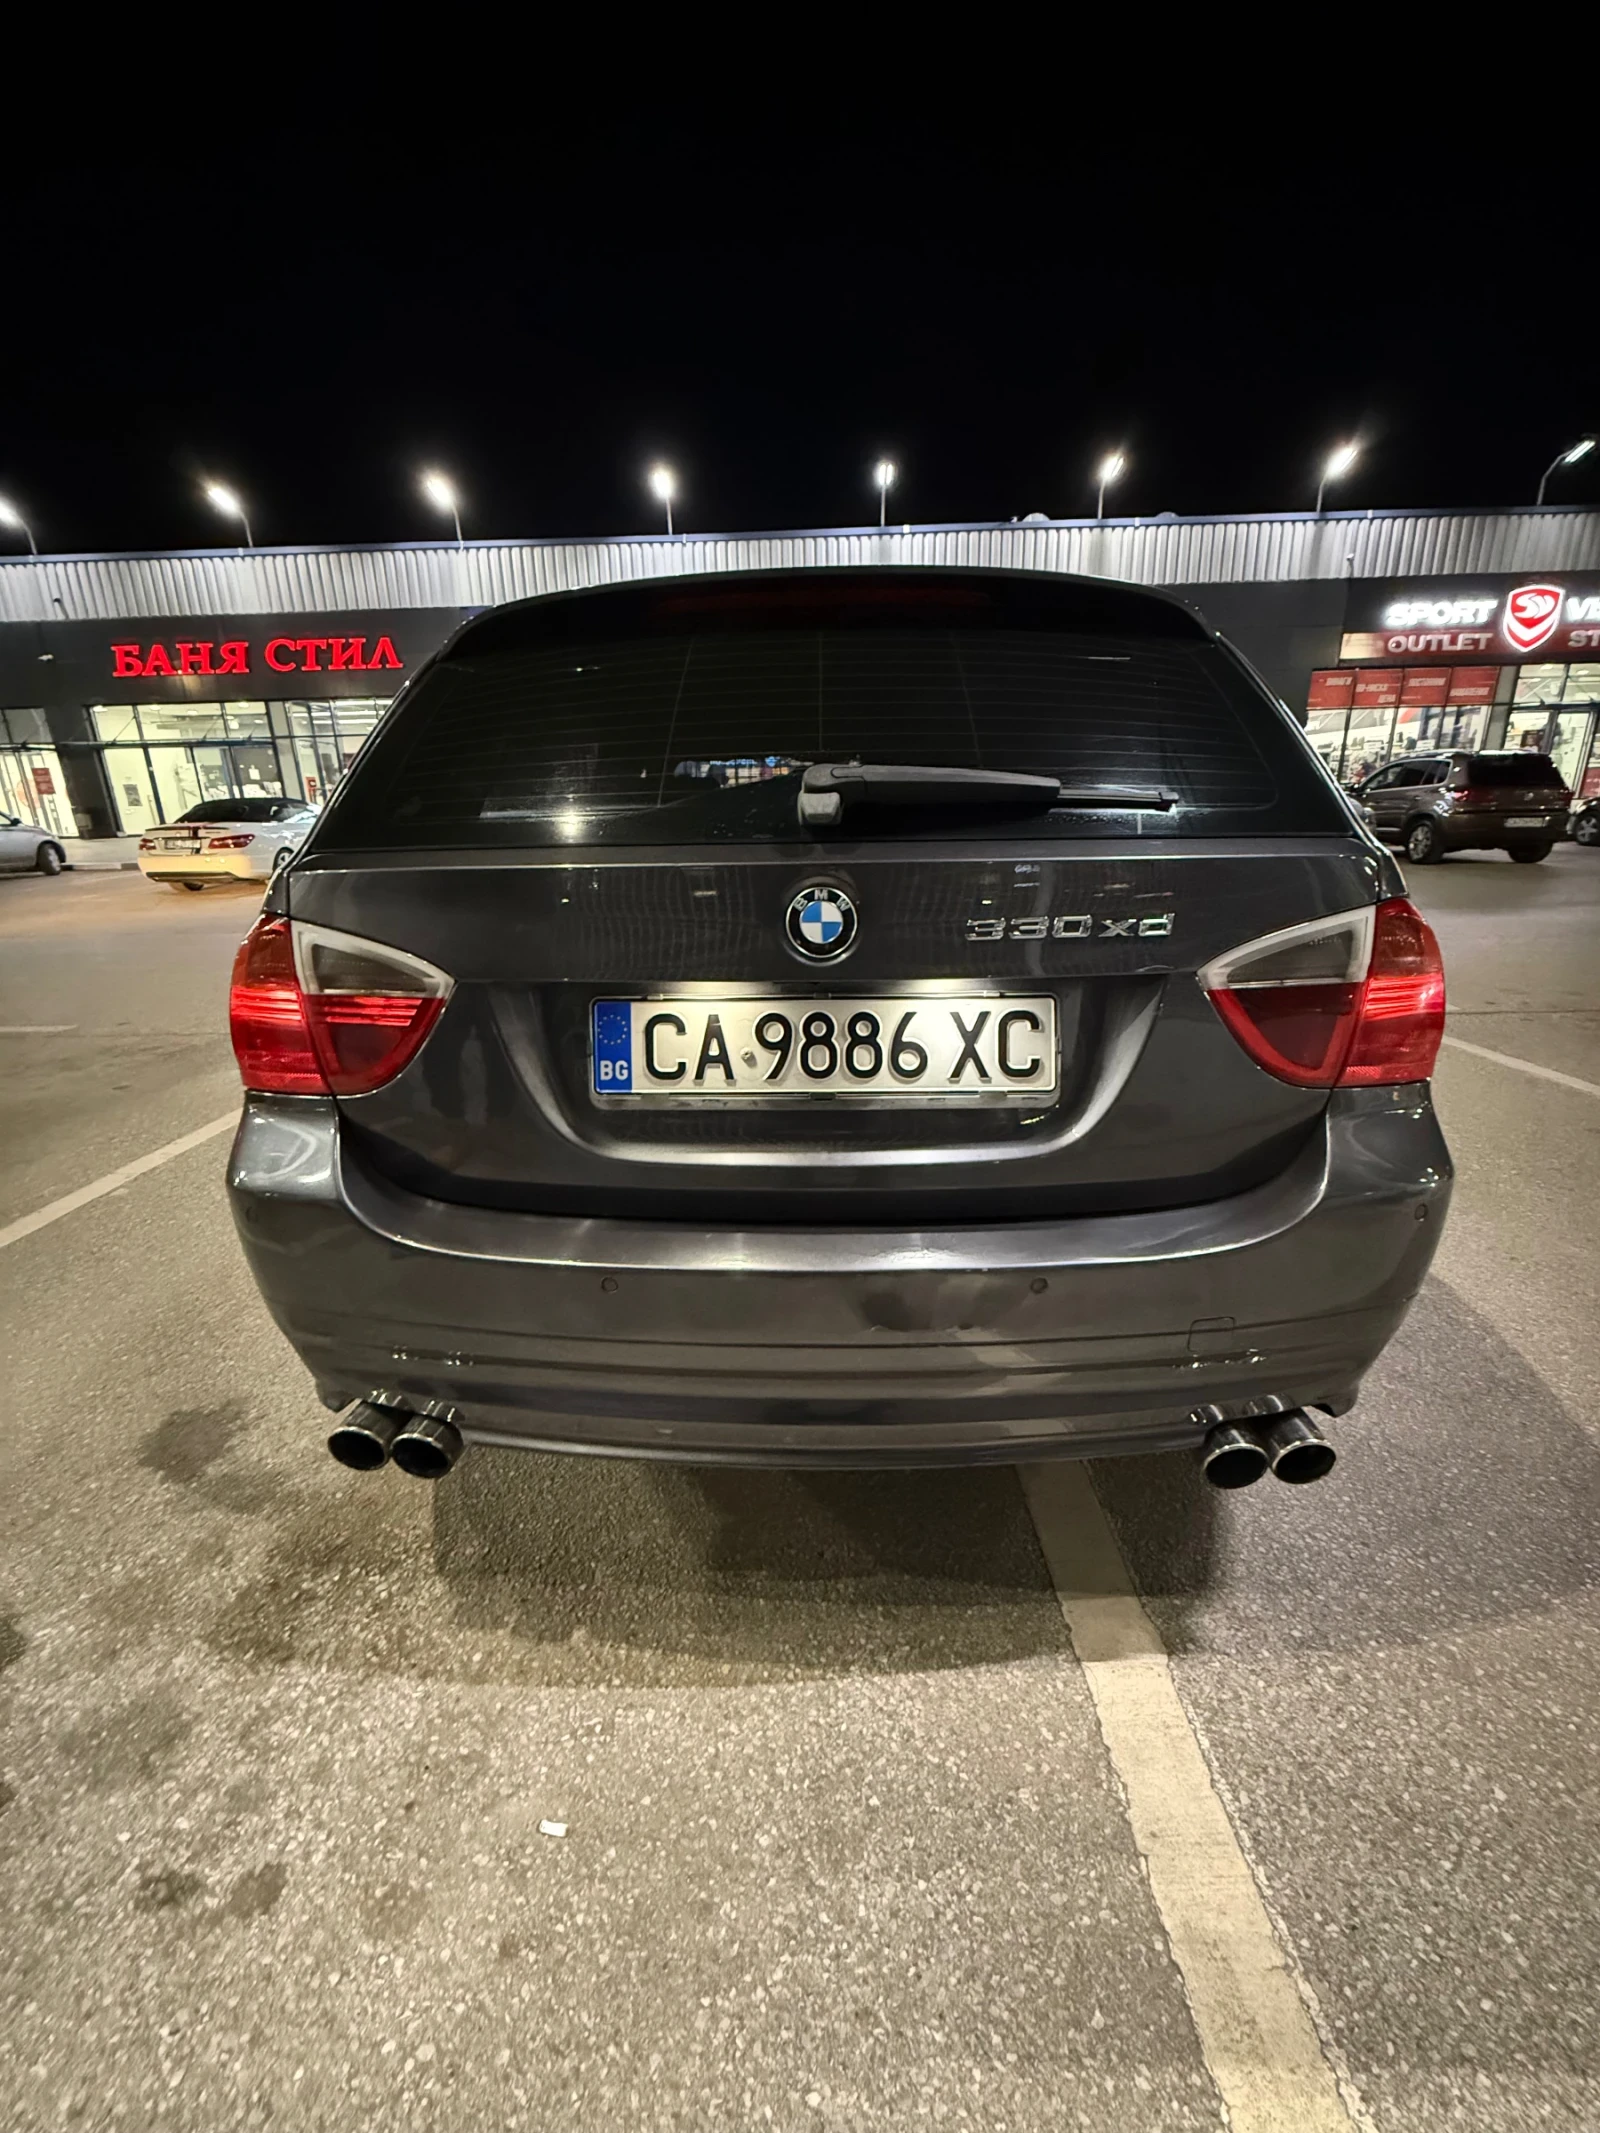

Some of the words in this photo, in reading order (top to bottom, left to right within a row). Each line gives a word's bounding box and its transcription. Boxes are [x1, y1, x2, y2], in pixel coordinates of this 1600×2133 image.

[1387, 600, 1498, 626] SPORT
[1388, 633, 1493, 653] OUTLET
[111, 641, 250, 677] БАНЯ
[264, 637, 403, 672] СТИЛ
[644, 1012, 734, 1081] CA
[753, 1011, 929, 1081] 9886
[948, 1009, 1042, 1081] XC
[600, 1061, 629, 1081] BG
